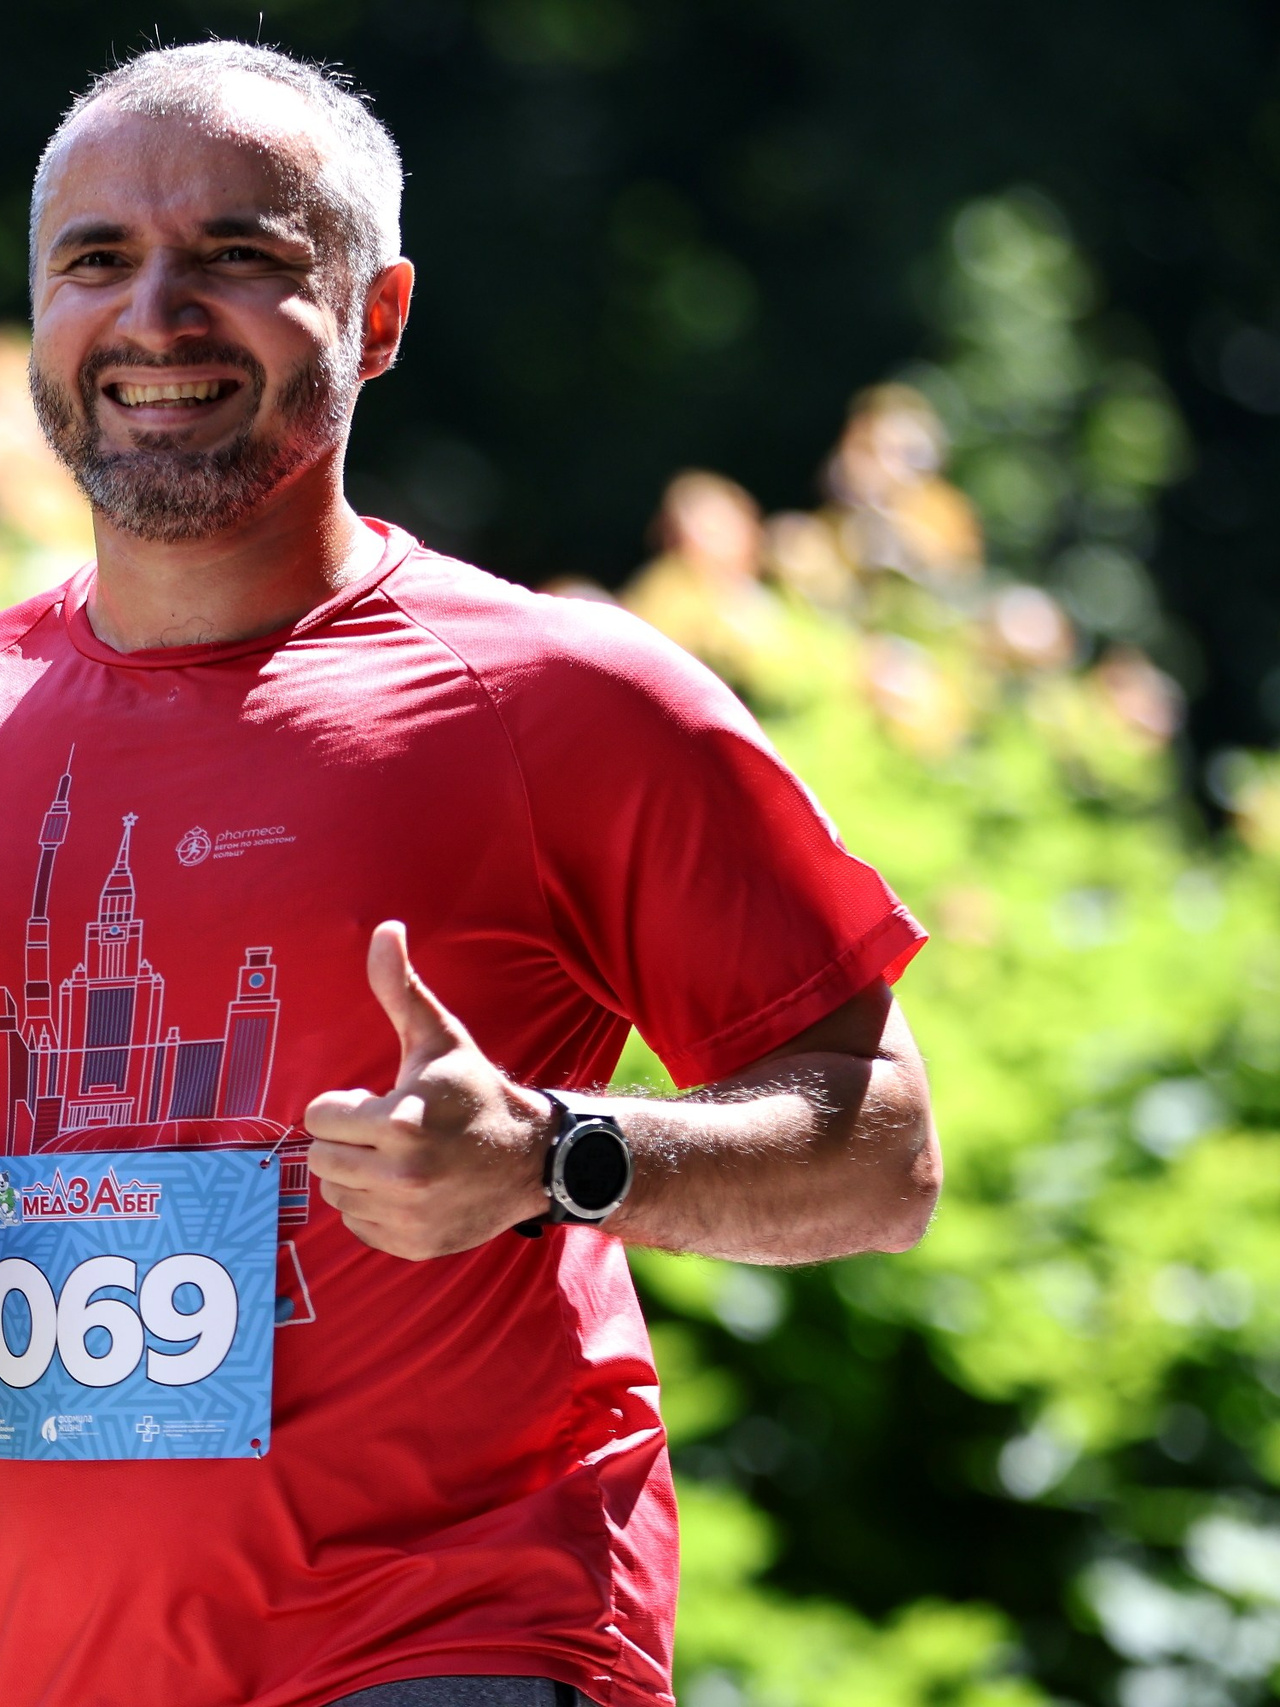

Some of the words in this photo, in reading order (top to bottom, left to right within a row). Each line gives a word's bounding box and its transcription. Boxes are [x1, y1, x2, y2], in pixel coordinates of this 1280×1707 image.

[215, 825, 286, 844] pharmeco
[214, 842, 239, 851] БЕГОМ
[240, 840, 252, 848] ПО
[253, 836, 297, 846] ЗОЛОТОМУ
[213, 849, 245, 859] КОЛЬЦУ
